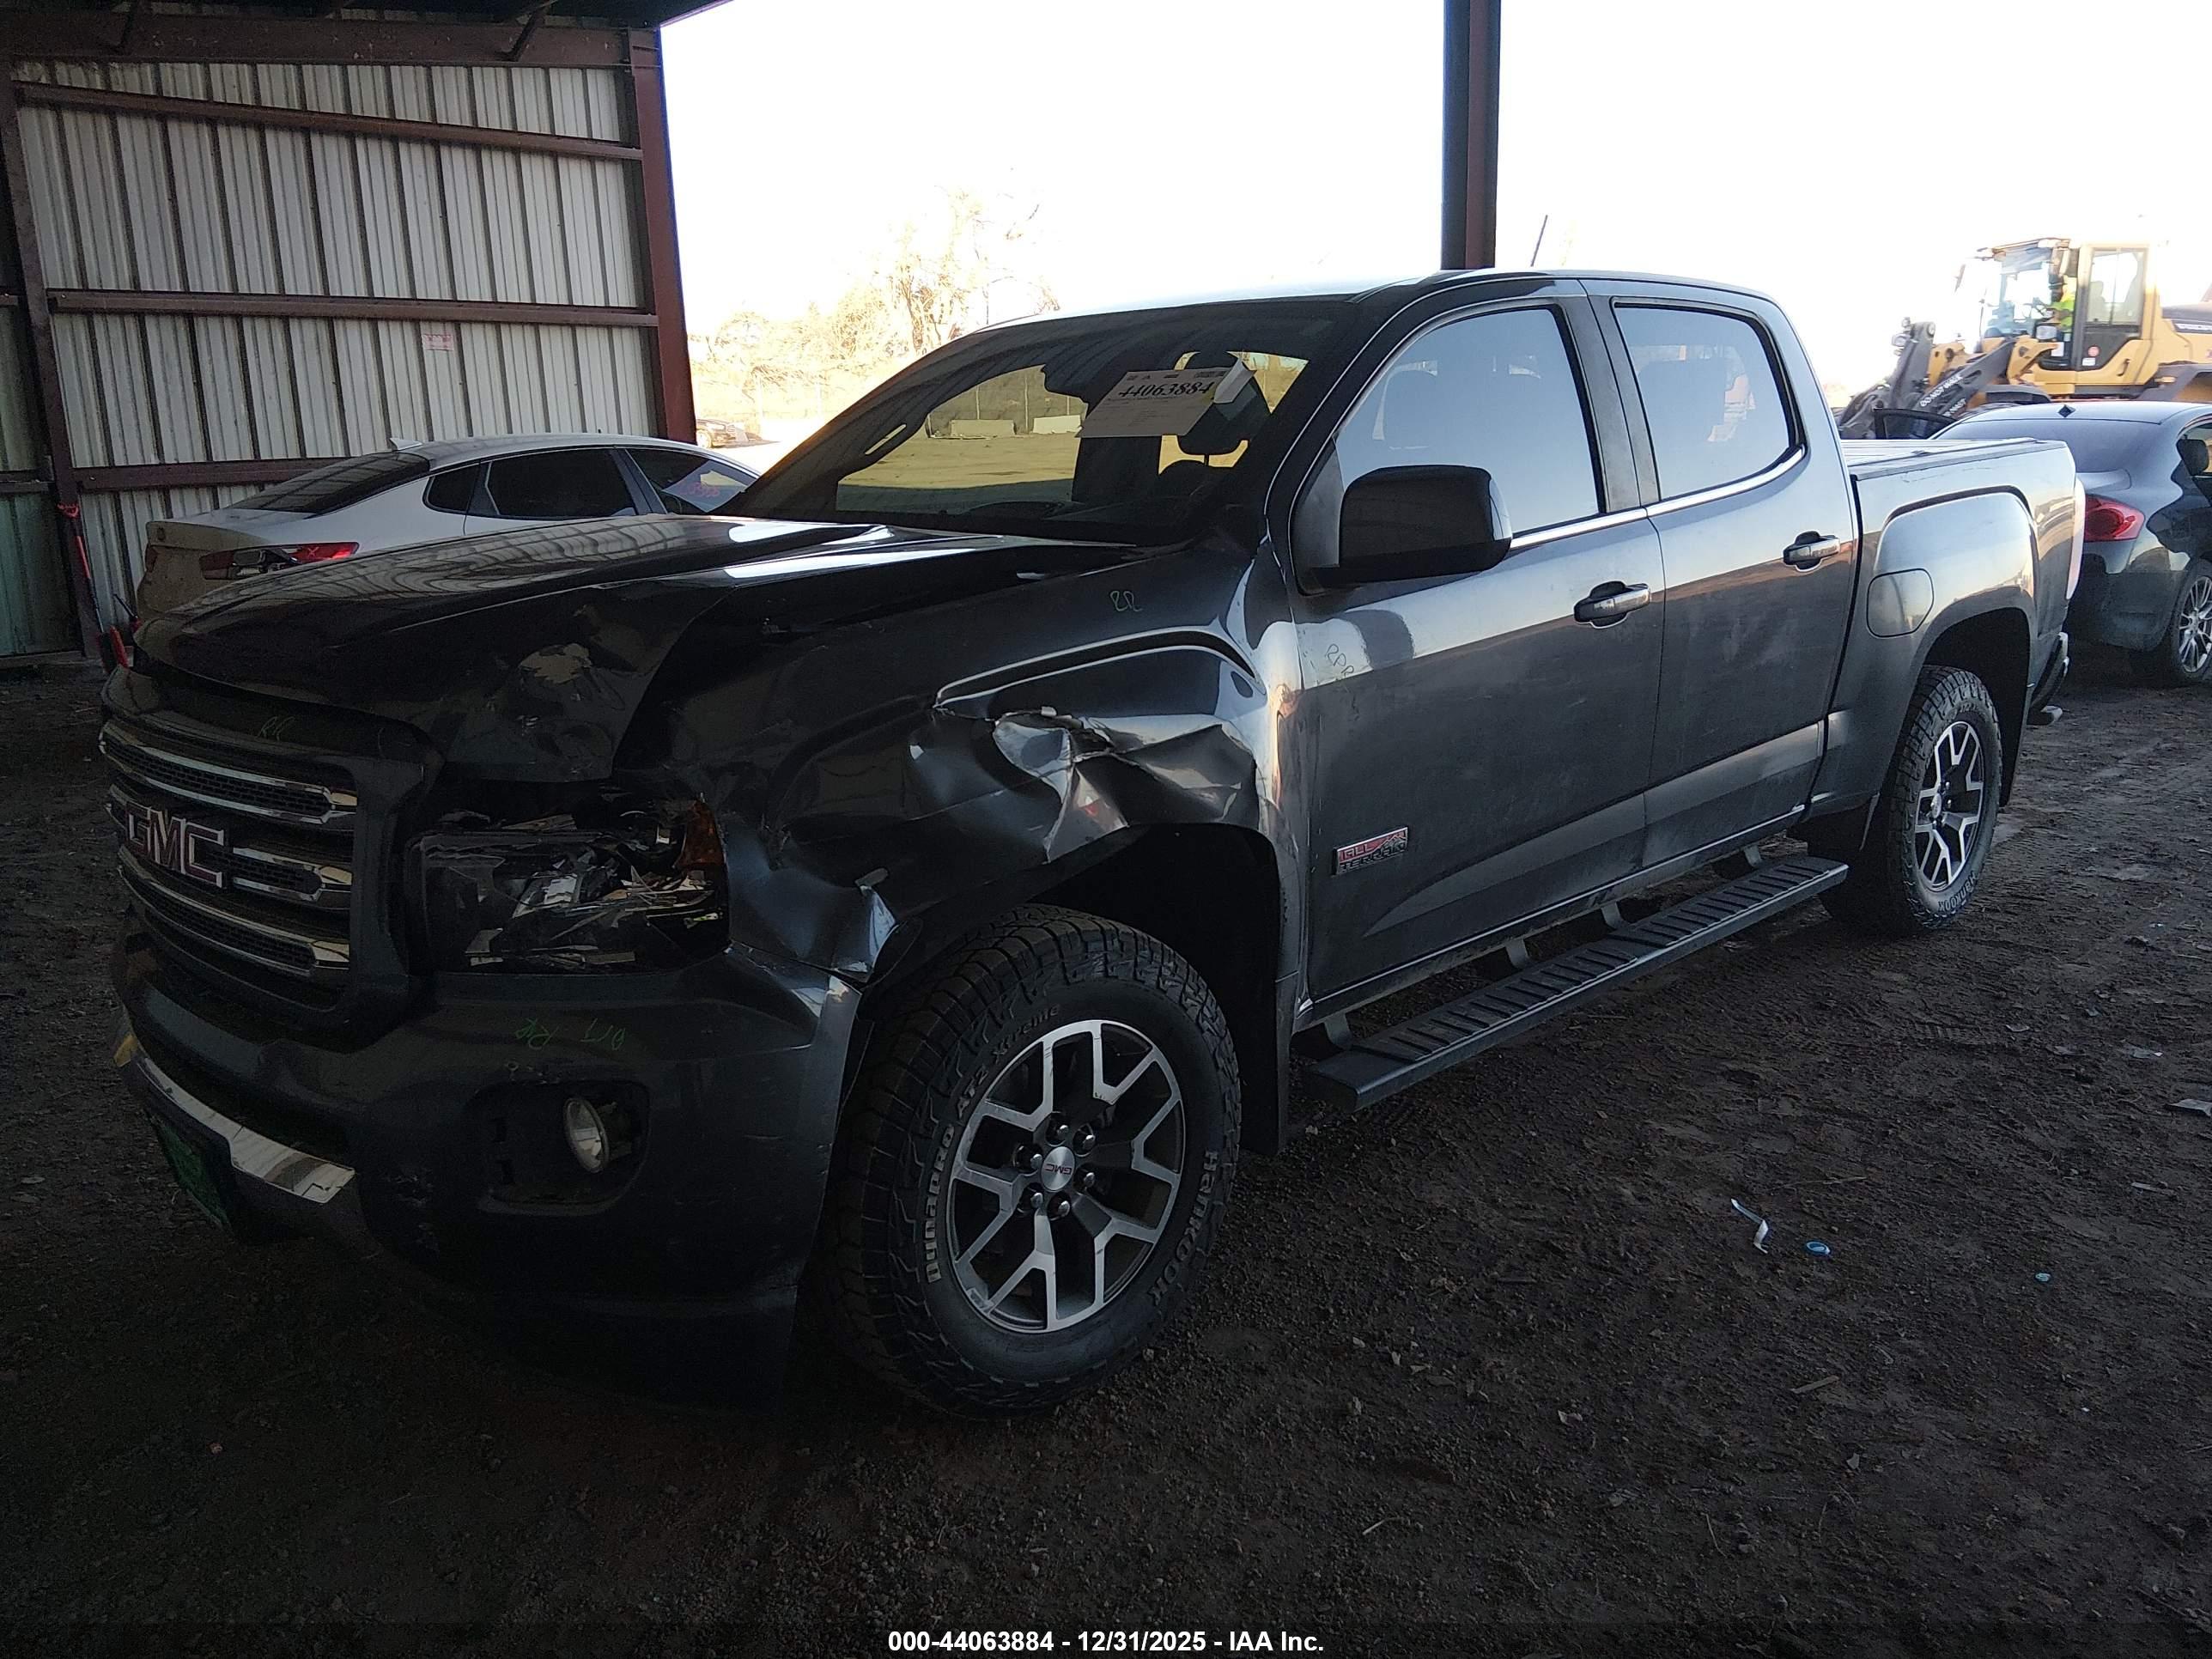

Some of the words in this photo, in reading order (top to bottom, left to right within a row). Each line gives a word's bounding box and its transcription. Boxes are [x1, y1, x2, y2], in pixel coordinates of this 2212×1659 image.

[1119, 381, 1215, 397] 44063884
[124, 800, 225, 889] GMC
[1342, 844, 1373, 860] ALL
[1044, 1163, 1073, 1176] GMC
